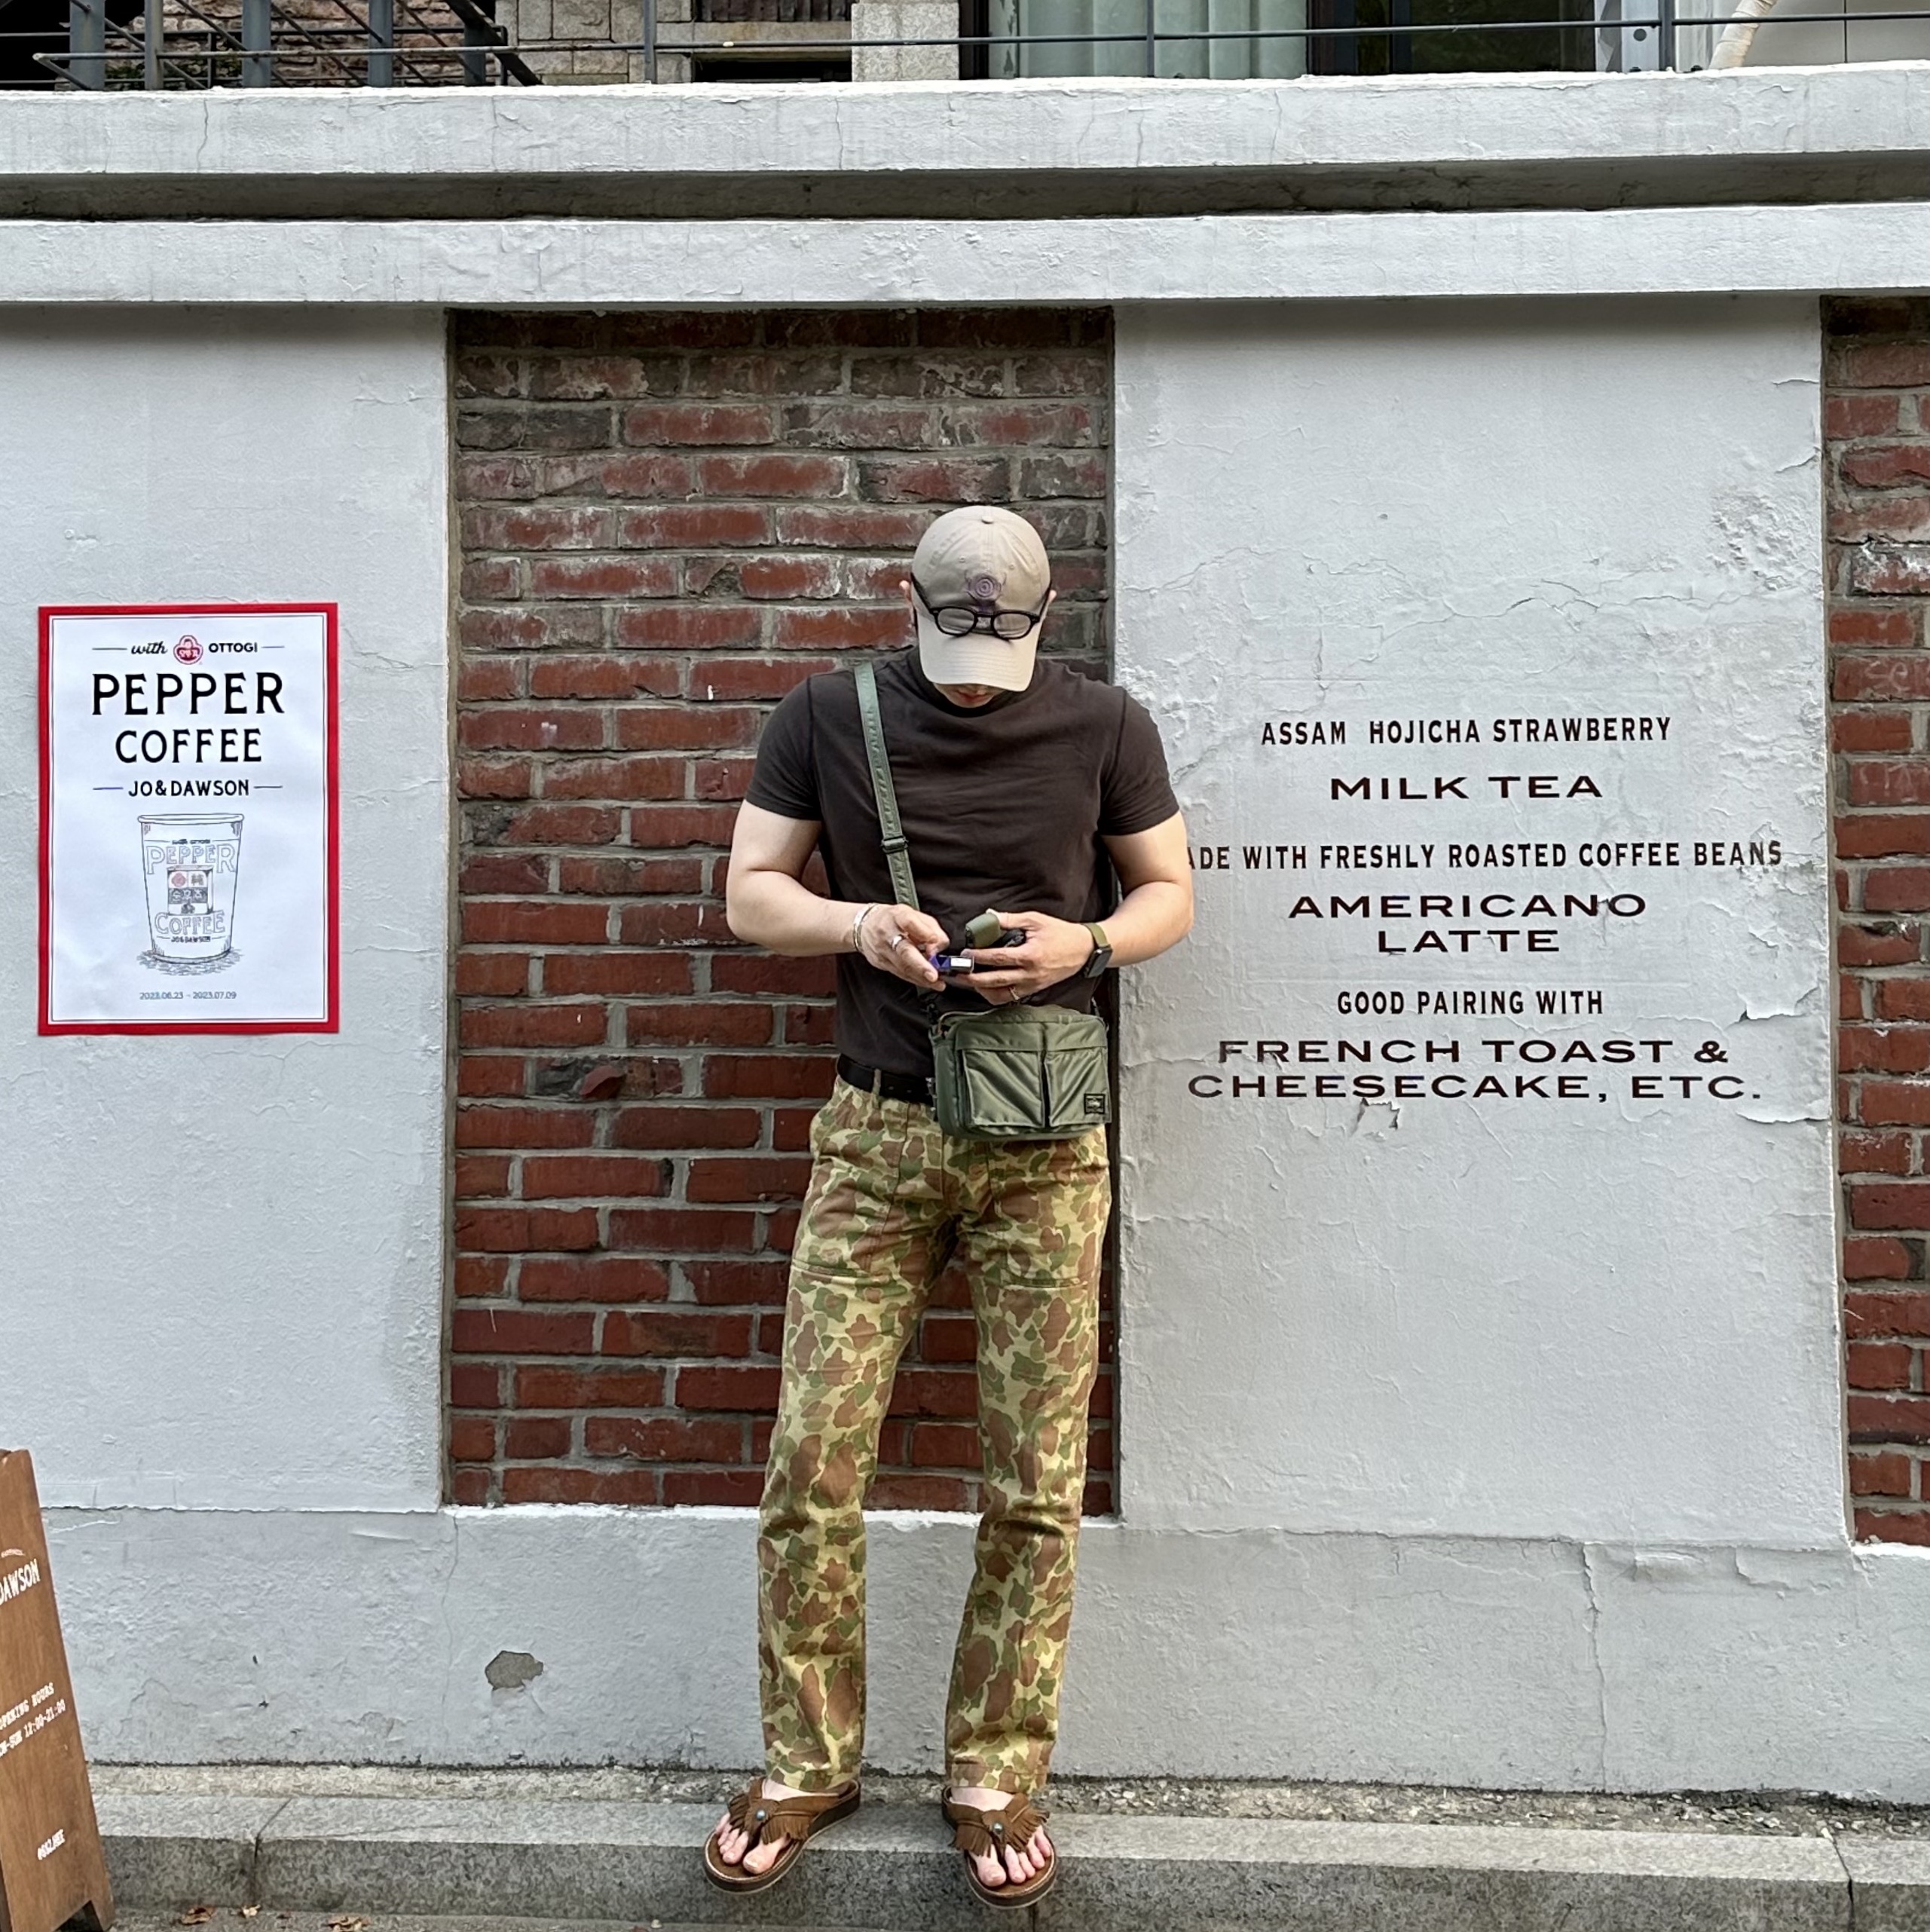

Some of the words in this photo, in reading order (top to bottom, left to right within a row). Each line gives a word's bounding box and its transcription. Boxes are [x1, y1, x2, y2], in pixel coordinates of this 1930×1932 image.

[131, 641, 167, 654] with
[208, 642, 257, 654] OTTOGI
[92, 672, 285, 715] PEPPER
[1261, 721, 1345, 746] ASSAM
[1369, 719, 1480, 744] HOJICHA
[1493, 716, 1671, 742] STRAWBERRY
[115, 728, 262, 764] COFFEE
[1331, 776, 1469, 801] MILK
[1488, 776, 1603, 799] TEA
[146, 844, 236, 874] PEPPER
[1242, 845, 1307, 869] WITH
[1320, 844, 1435, 869] FRESHLY
[1448, 843, 1566, 868] ROASTED
[1579, 842, 1680, 867] COFFEE
[1693, 840, 1782, 866] BEANS
[1288, 893, 1647, 919] AMERICANO
[154, 910, 225, 935] COFFEE
[1378, 929, 1560, 954] LATTE
[1337, 990, 1405, 1015] GOOD
[1418, 990, 1525, 1015] PAIRING
[1535, 990, 1604, 1015] WITH
[1218, 1039, 1460, 1064] FRENCH
[1482, 1039, 1673, 1064] TOAST
[1693, 1040, 1729, 1064] &
[1188, 1075, 1607, 1102] CHEESECAKE,
[1632, 1076, 1761, 1099] ETC.
